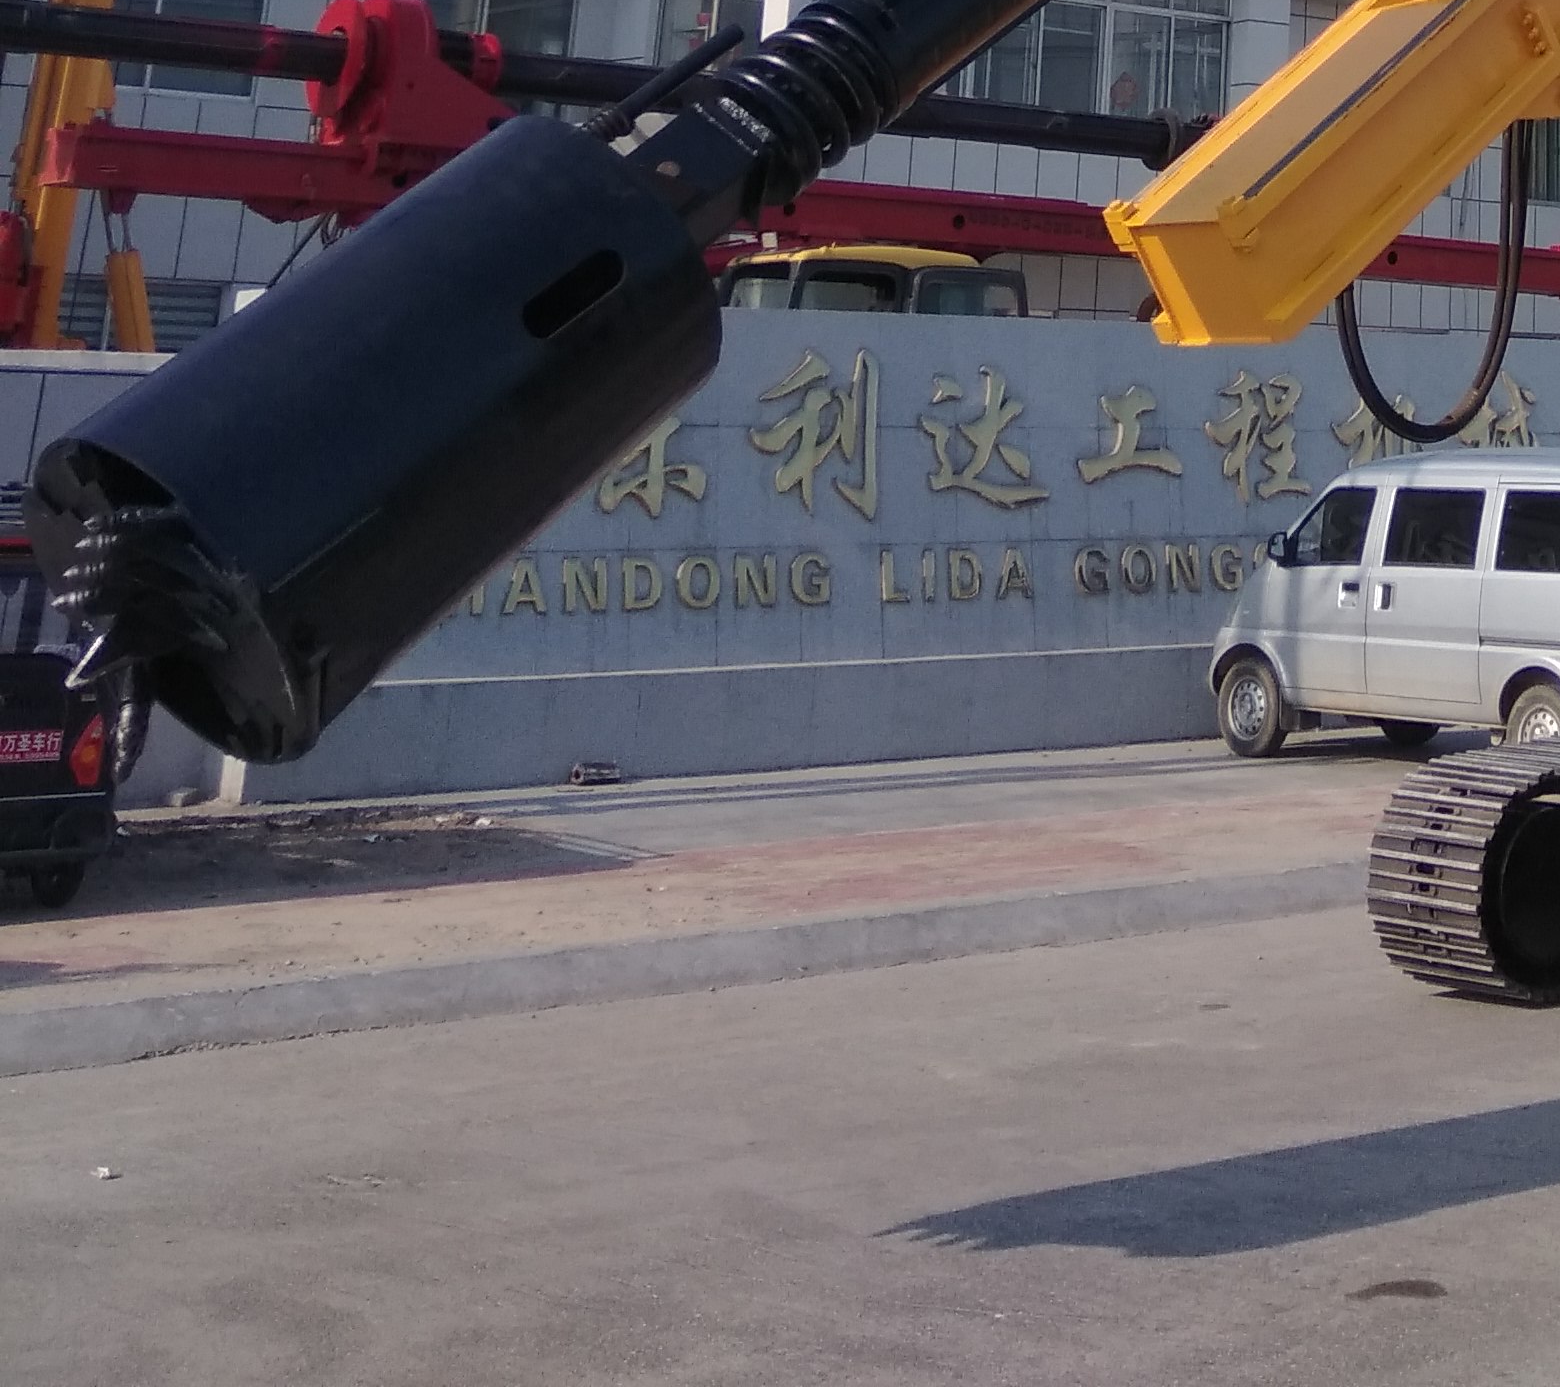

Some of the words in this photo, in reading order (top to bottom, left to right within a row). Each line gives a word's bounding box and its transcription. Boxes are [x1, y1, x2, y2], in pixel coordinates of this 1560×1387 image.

[880, 546, 1034, 604] LIDA
[1074, 540, 1268, 597] GONG
[0, 732, 61, 752] 万圣车行
